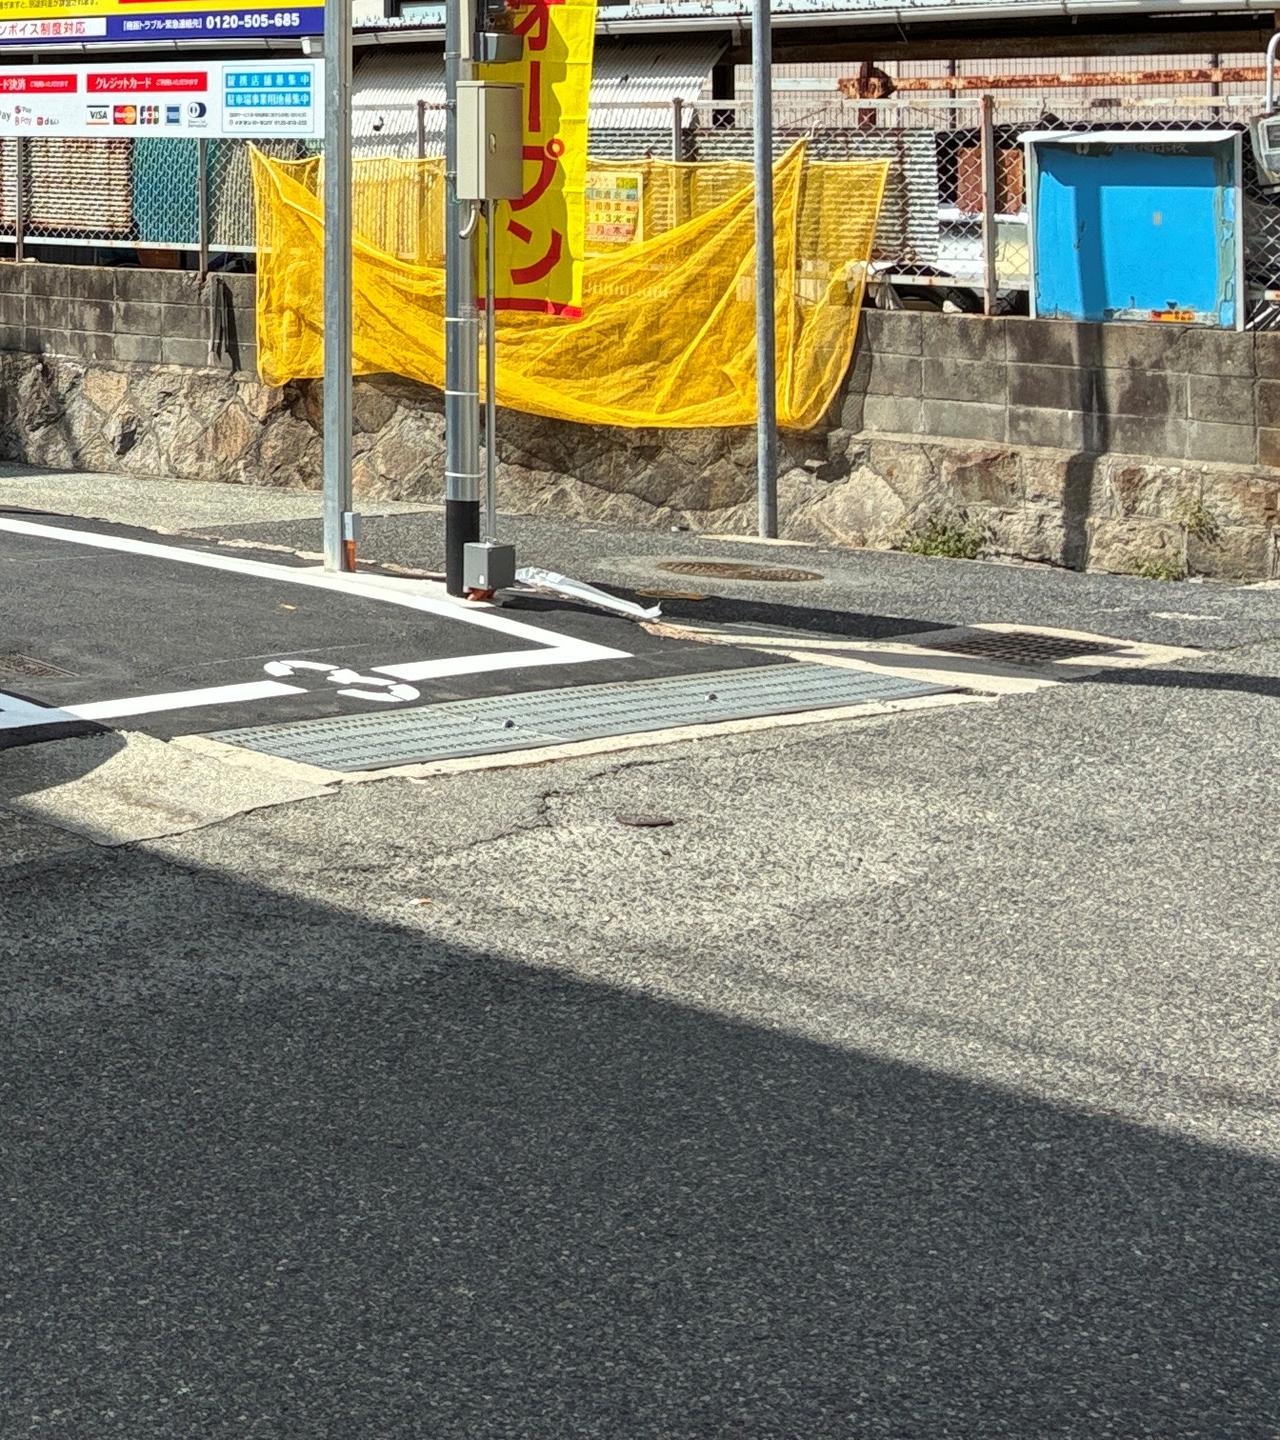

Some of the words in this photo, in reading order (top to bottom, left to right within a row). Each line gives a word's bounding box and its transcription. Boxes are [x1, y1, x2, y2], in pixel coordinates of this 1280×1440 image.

[206, 13, 300, 30] 0120-505-685
[95, 77, 152, 90] クレジットカード
[89, 111, 108, 120] VISA
[263, 659, 420, 703] 3
